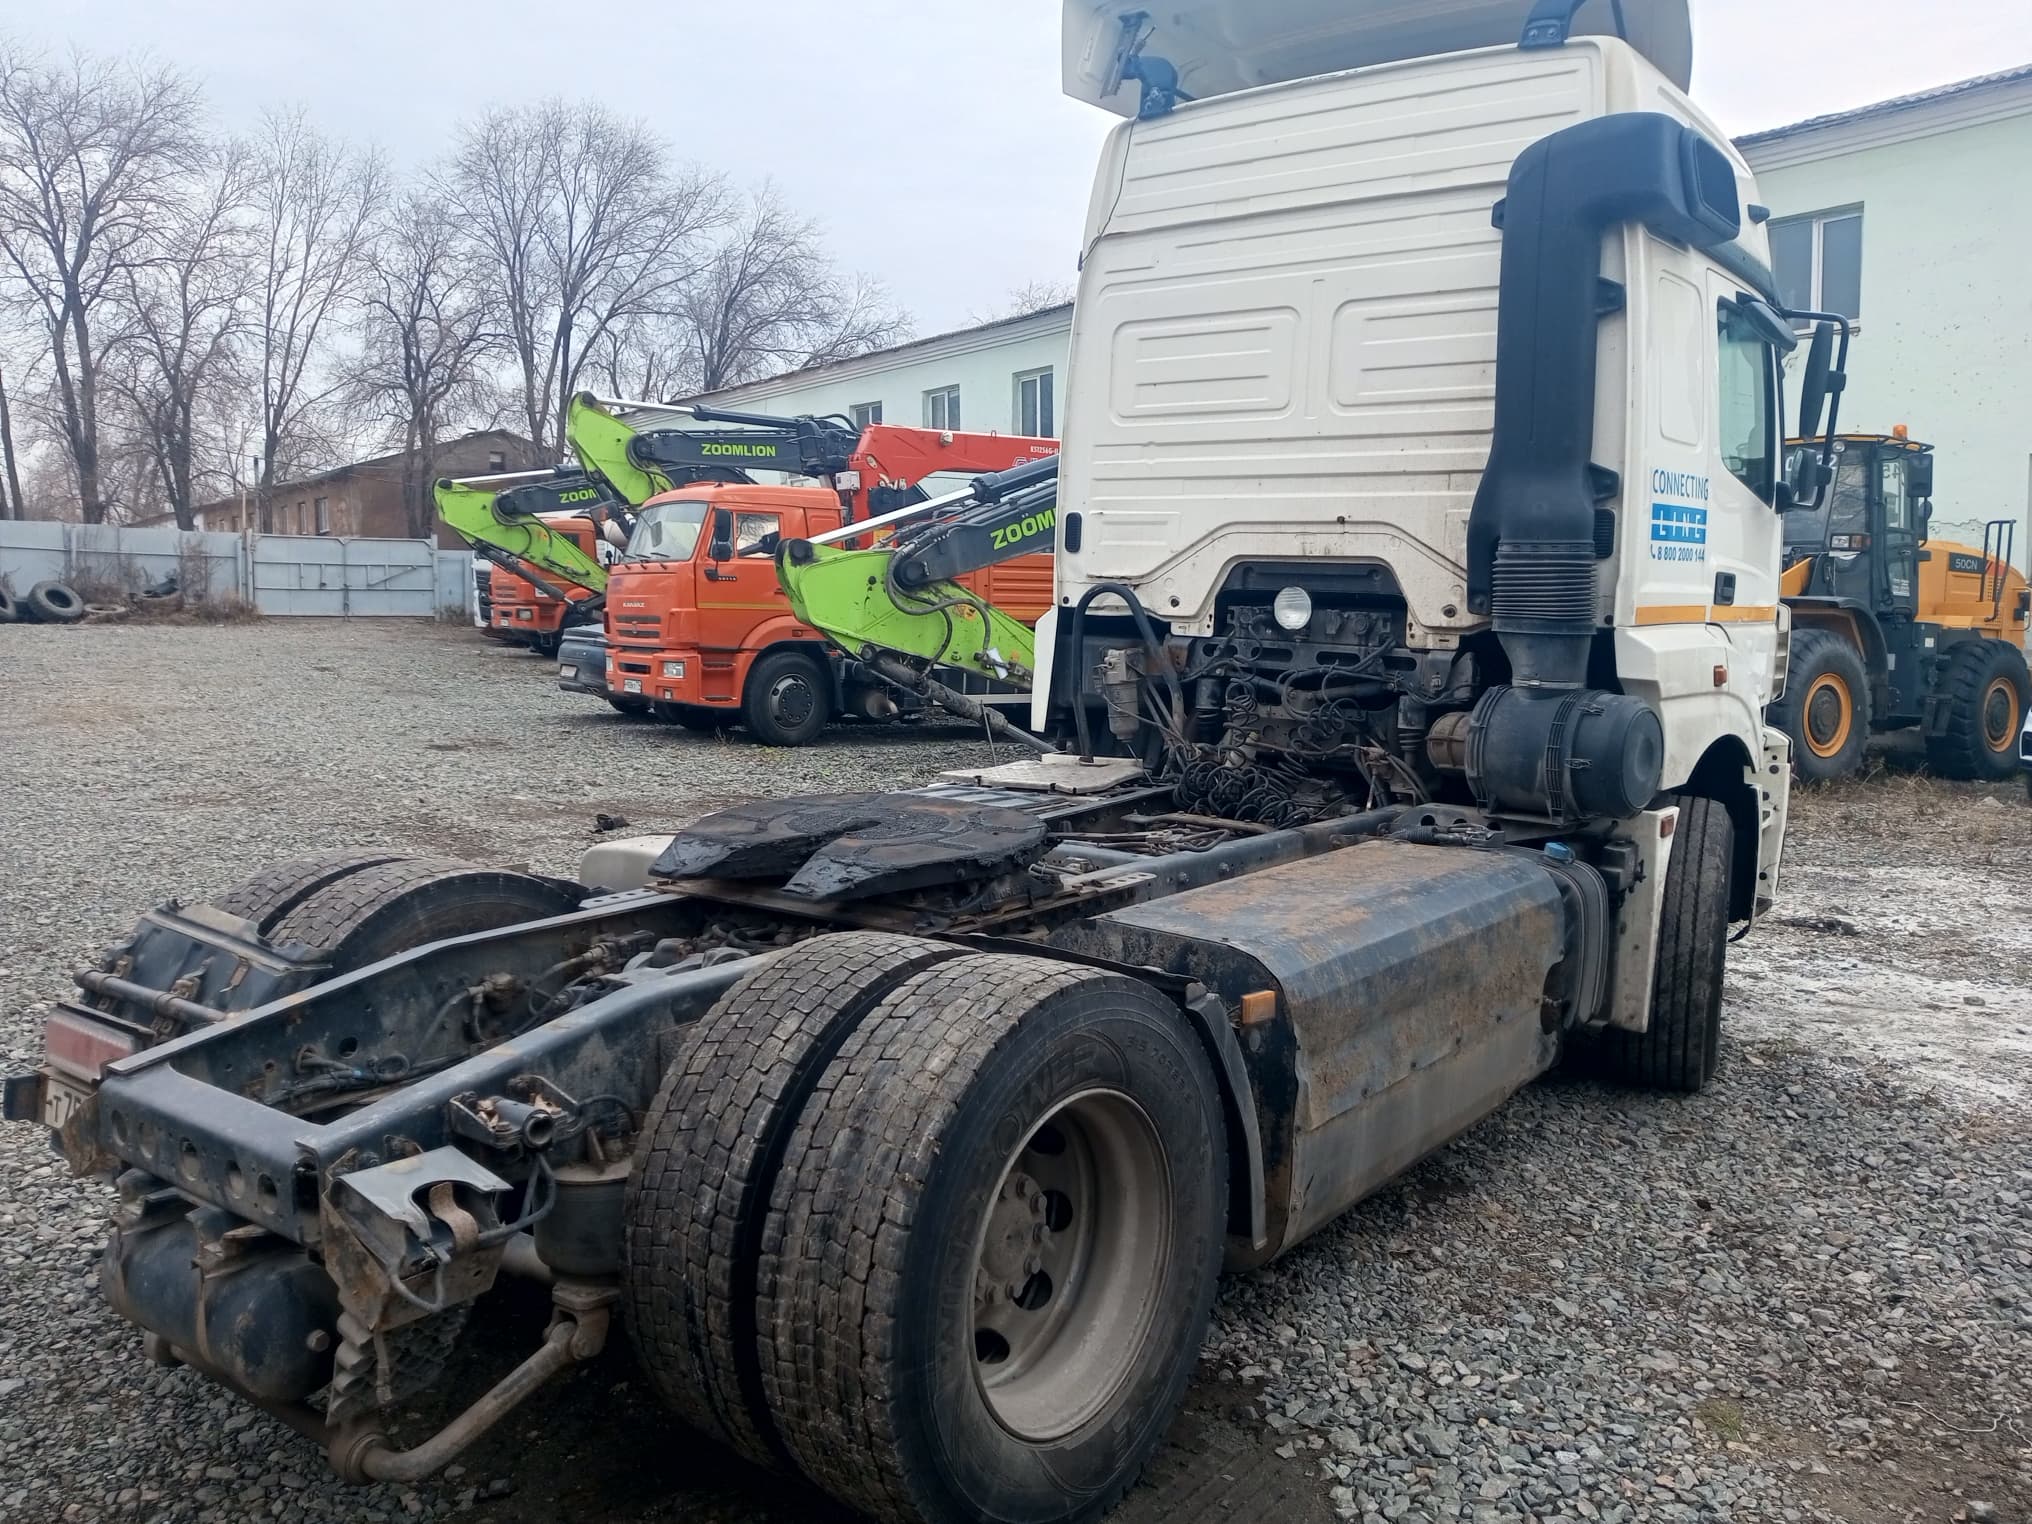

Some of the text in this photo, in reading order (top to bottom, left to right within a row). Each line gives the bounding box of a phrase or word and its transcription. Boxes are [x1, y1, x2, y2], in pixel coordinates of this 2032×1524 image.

[701, 443, 776, 457] ZOOMLION
[1653, 469, 1709, 501] CONNECTING
[991, 507, 1056, 550] ZOOM
[1659, 509, 1701, 539] LINE
[1664, 546, 1677, 561] 800
[1678, 547, 1693, 562] 2000
